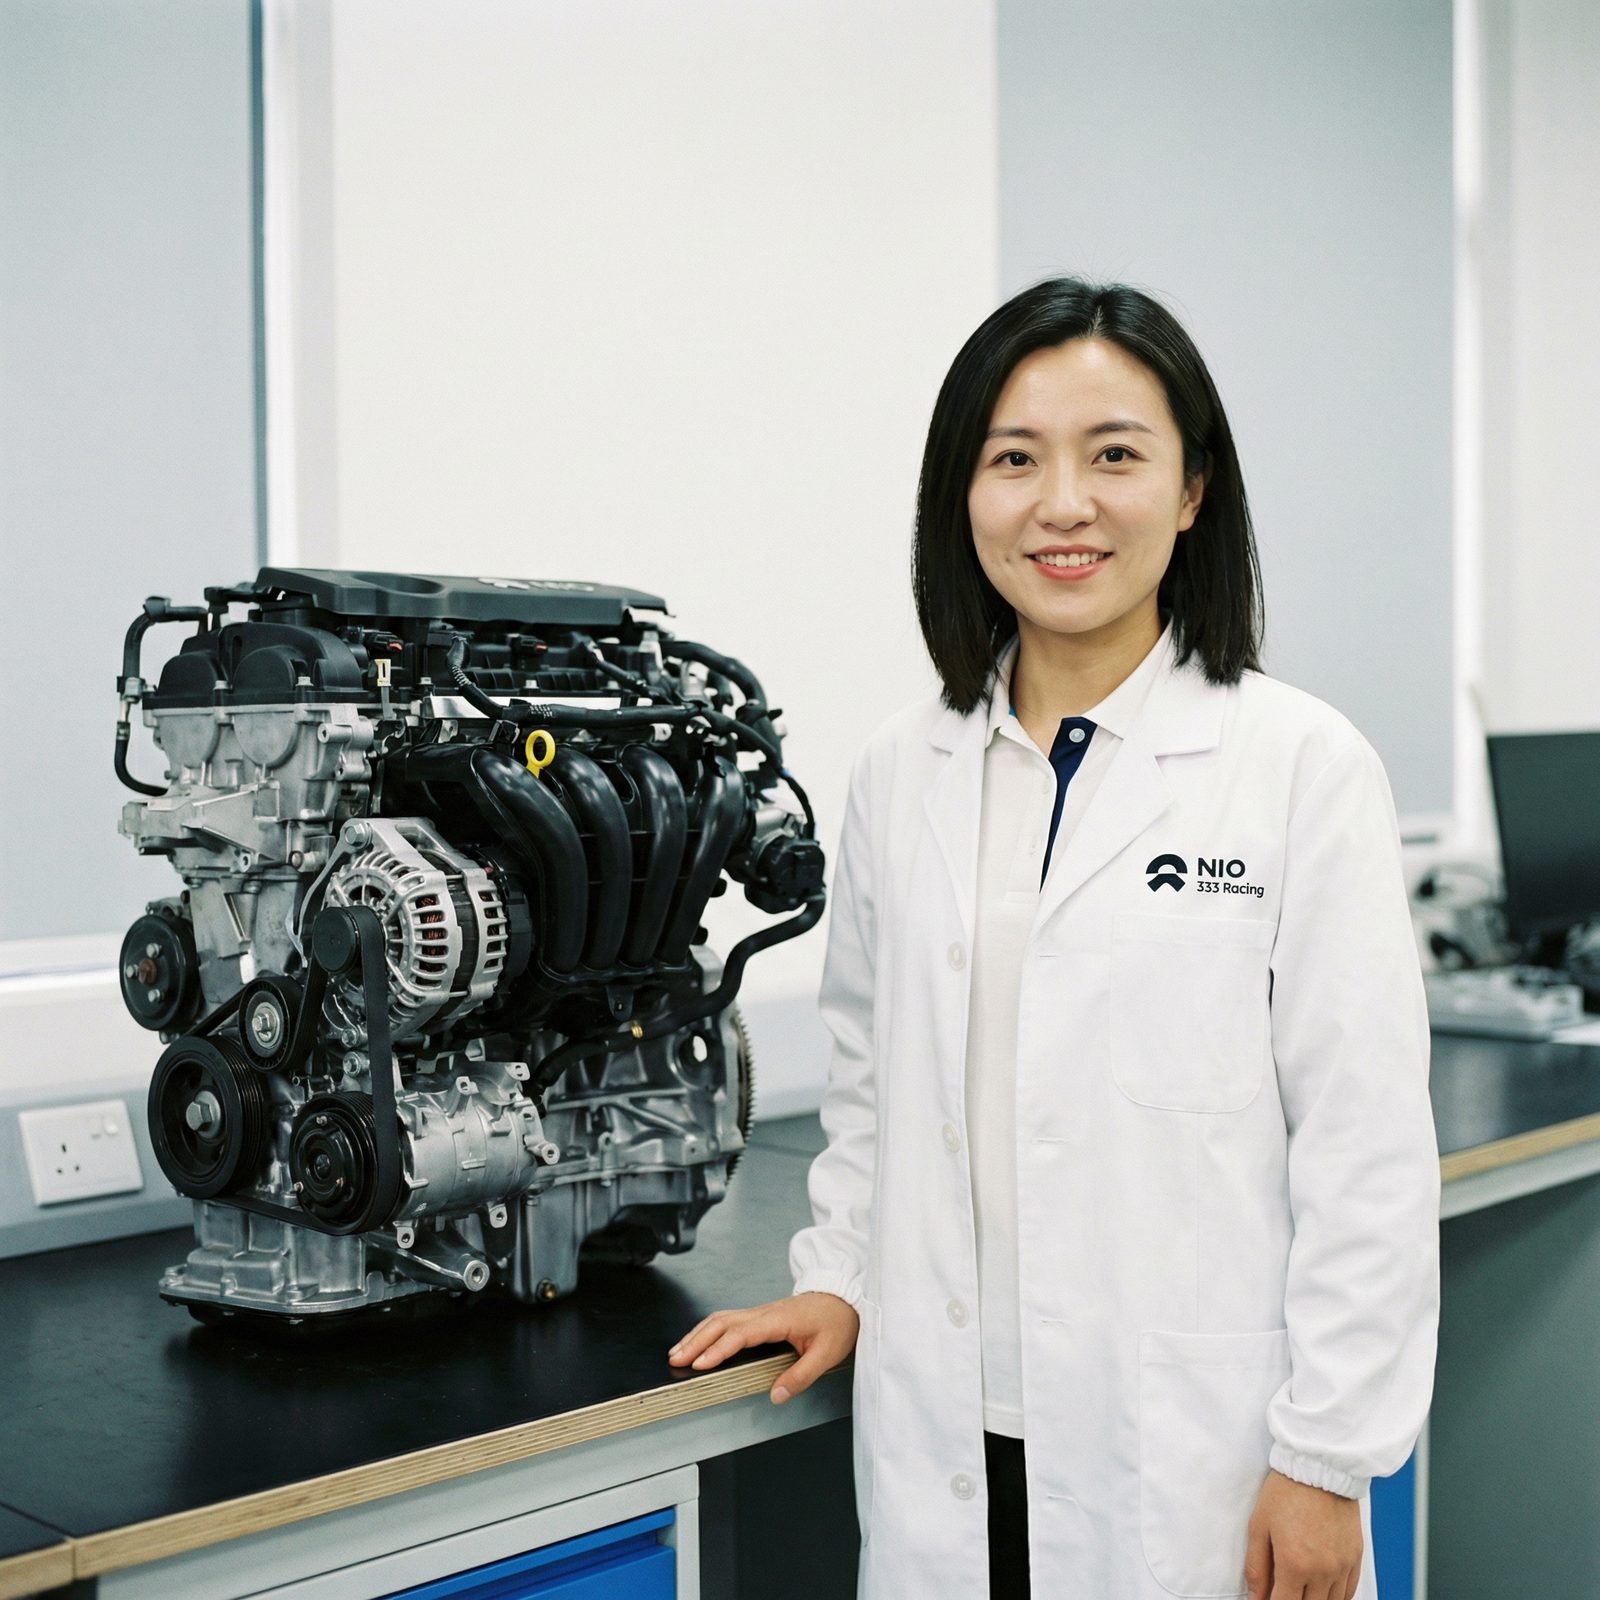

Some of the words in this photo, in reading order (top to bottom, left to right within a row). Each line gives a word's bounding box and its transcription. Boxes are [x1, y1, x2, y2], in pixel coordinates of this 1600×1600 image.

[1198, 857, 1246, 878] NIO
[1197, 881, 1220, 893] 333
[1223, 882, 1265, 898] Racing
